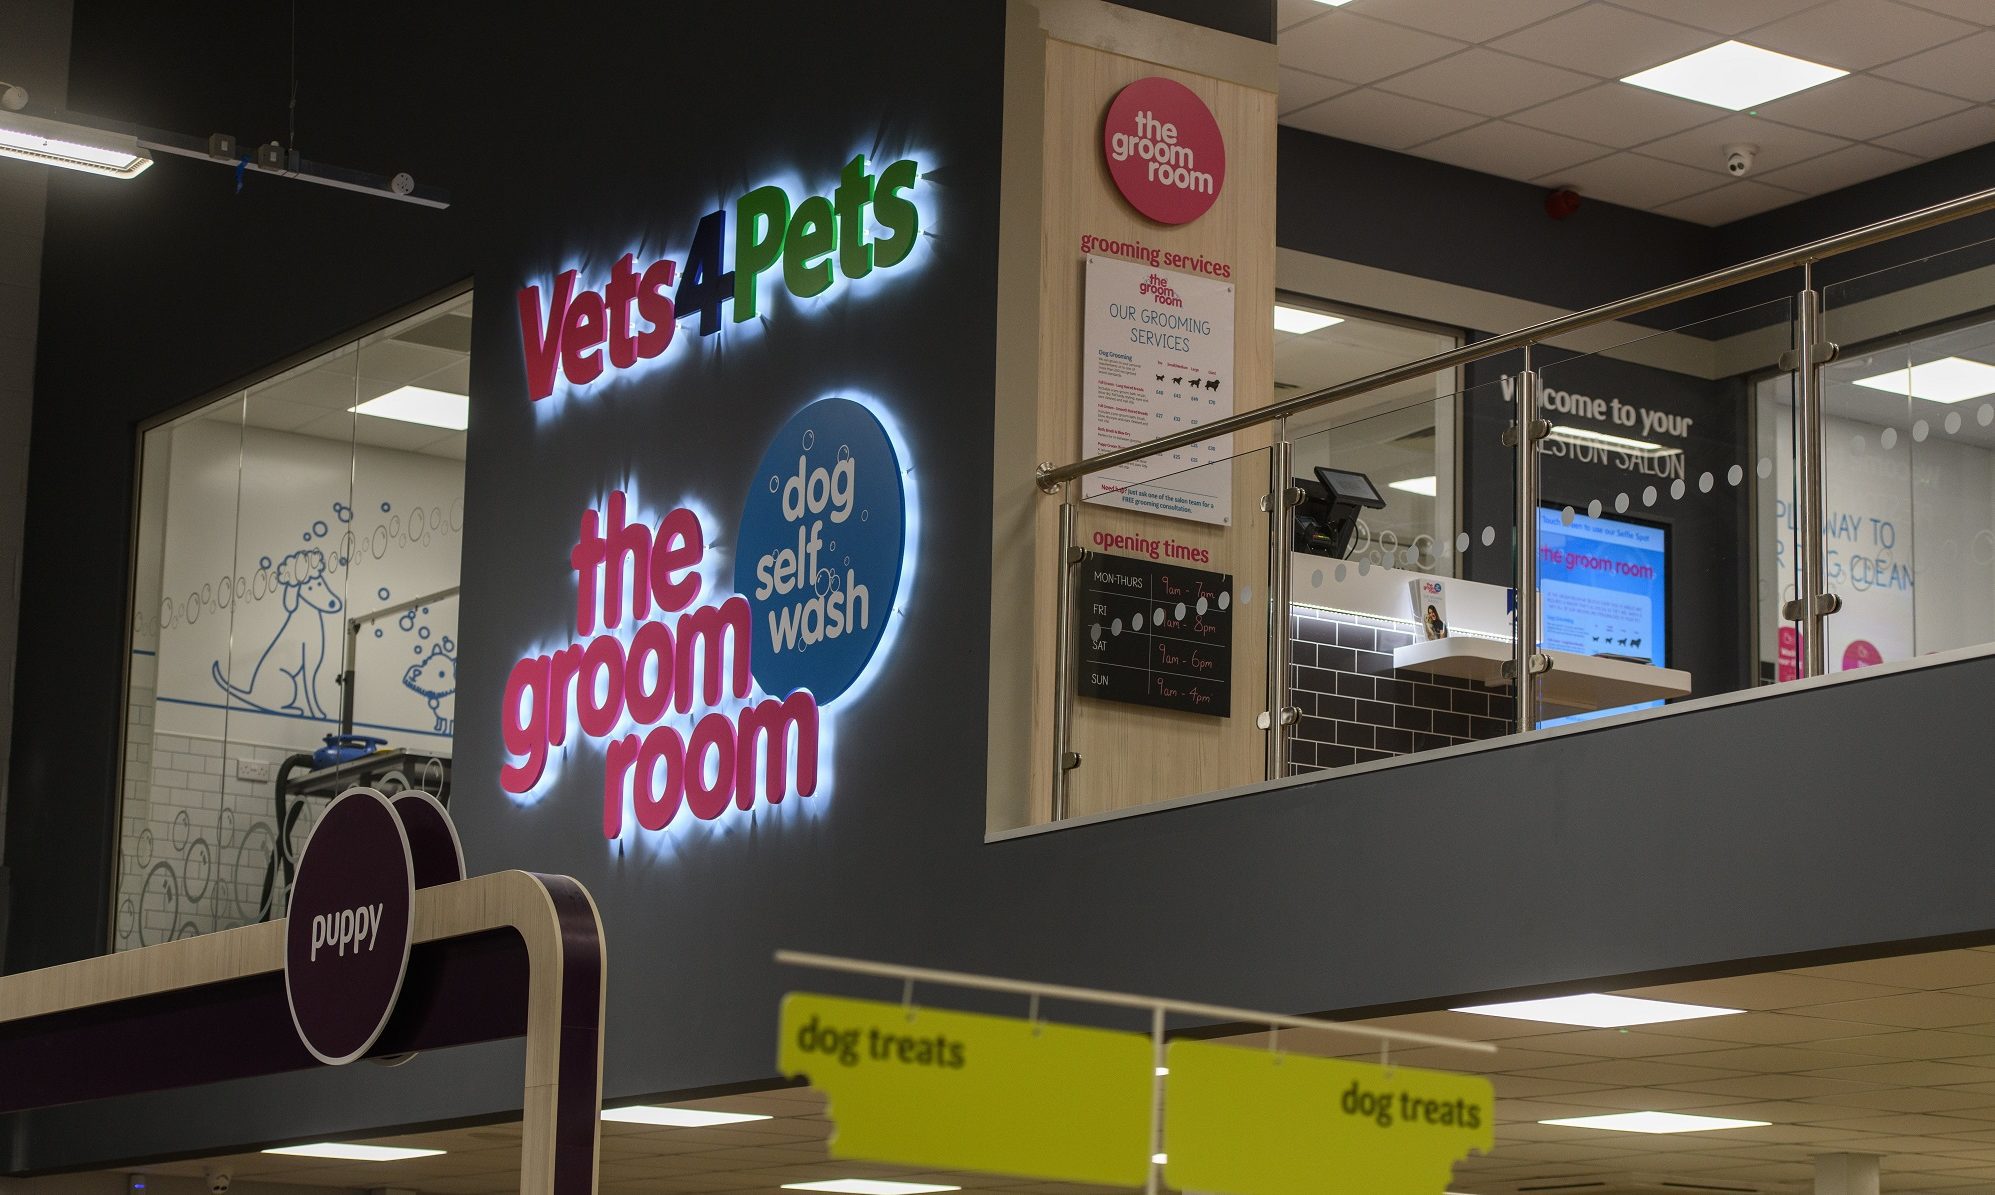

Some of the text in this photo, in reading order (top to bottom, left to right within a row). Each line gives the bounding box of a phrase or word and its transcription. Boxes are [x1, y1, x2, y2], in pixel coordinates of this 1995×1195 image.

[1135, 110, 1178, 144] the
[1112, 132, 1193, 169] groom
[1148, 161, 1213, 194] room
[1080, 234, 1231, 278] grooming services
[517, 153, 919, 402] Vets4Pets
[1139, 282, 1174, 298] groom
[1149, 273, 1168, 288] the
[1155, 295, 1183, 308] room
[1109, 303, 1211, 335] OUR GROOMING
[1130, 327, 1190, 353] SERVICES
[1610, 398, 1636, 427] to
[1640, 408, 1693, 438] your
[782, 454, 855, 523] dog
[1122, 496, 1134, 504] FREE
[1134, 499, 1160, 510] grooming
[1092, 532, 1209, 563] opening times
[1870, 518, 1896, 550] TO
[570, 490, 703, 637] the
[756, 521, 823, 601] self
[1540, 544, 1653, 579] the groom room
[1093, 571, 1143, 588] MON-THURS
[1162, 576, 1181, 595] 9am
[768, 570, 869, 654] wash
[1093, 603, 1107, 616] FRI
[1194, 614, 1216, 637] 8pm
[1092, 640, 1107, 651] SAT
[1159, 643, 1179, 664] 9am
[1191, 650, 1213, 671] 6pm
[500, 597, 752, 793] groom
[1091, 673, 1109, 686] SUN
[1157, 677, 1177, 695] 9am
[1189, 687, 1210, 704] 4pm
[603, 692, 818, 840] room
[311, 902, 383, 962] puppy
[797, 1014, 965, 1070] dog treats
[1342, 1080, 1482, 1130] dog treats
